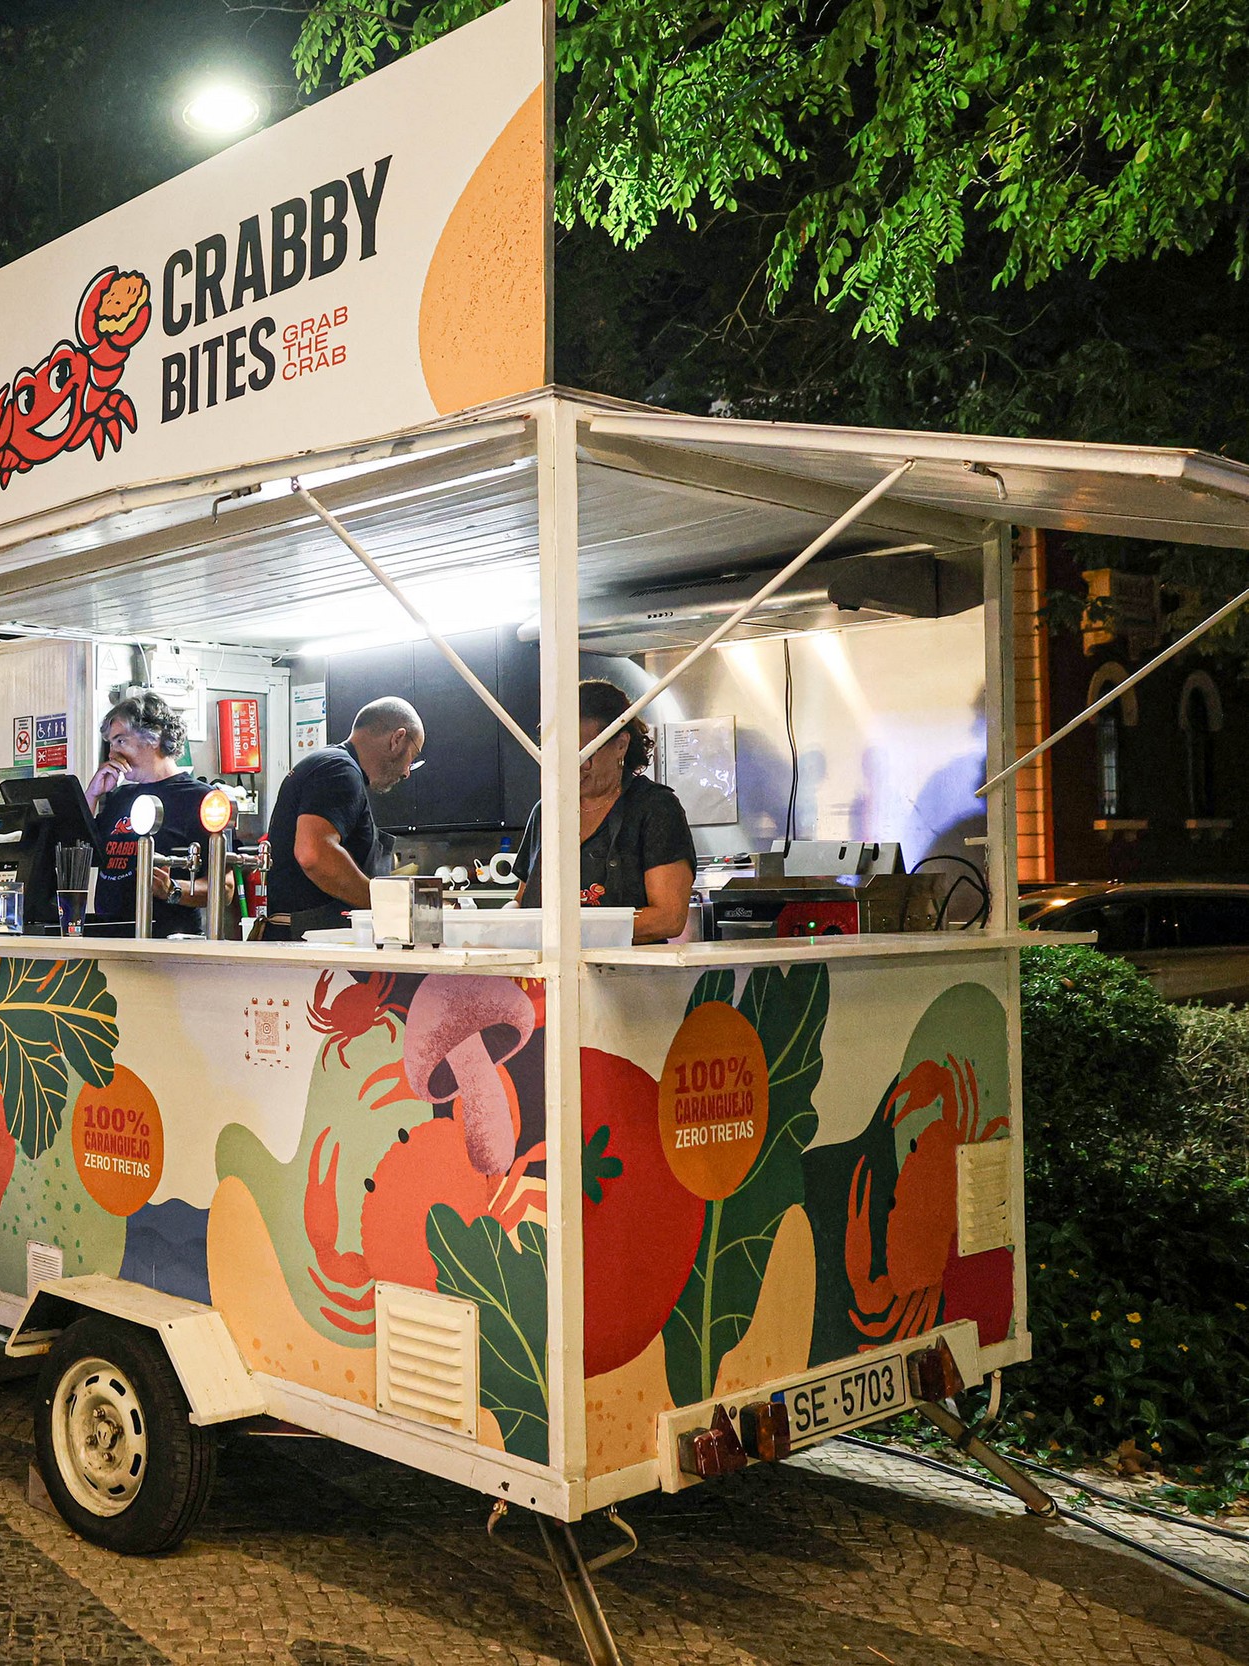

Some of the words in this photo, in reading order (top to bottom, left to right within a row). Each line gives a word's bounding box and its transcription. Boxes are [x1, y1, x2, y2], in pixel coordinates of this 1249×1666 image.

[162, 155, 393, 337] CRABBY
[282, 306, 348, 343] GRAB
[282, 331, 329, 361] THE
[282, 345, 347, 380] CRAB
[161, 316, 276, 424] BITES
[249, 702, 257, 746] BLANKET
[674, 1056, 754, 1094] 100%
[84, 1104, 150, 1136] 100%
[675, 1091, 754, 1124] CARANGUEJO
[84, 1130, 150, 1160] CARANGUEJO
[675, 1125, 708, 1149] ZERO
[710, 1120, 754, 1143] TRETAS
[84, 1153, 111, 1171] ZERO
[112, 1158, 150, 1178] TRETAS
